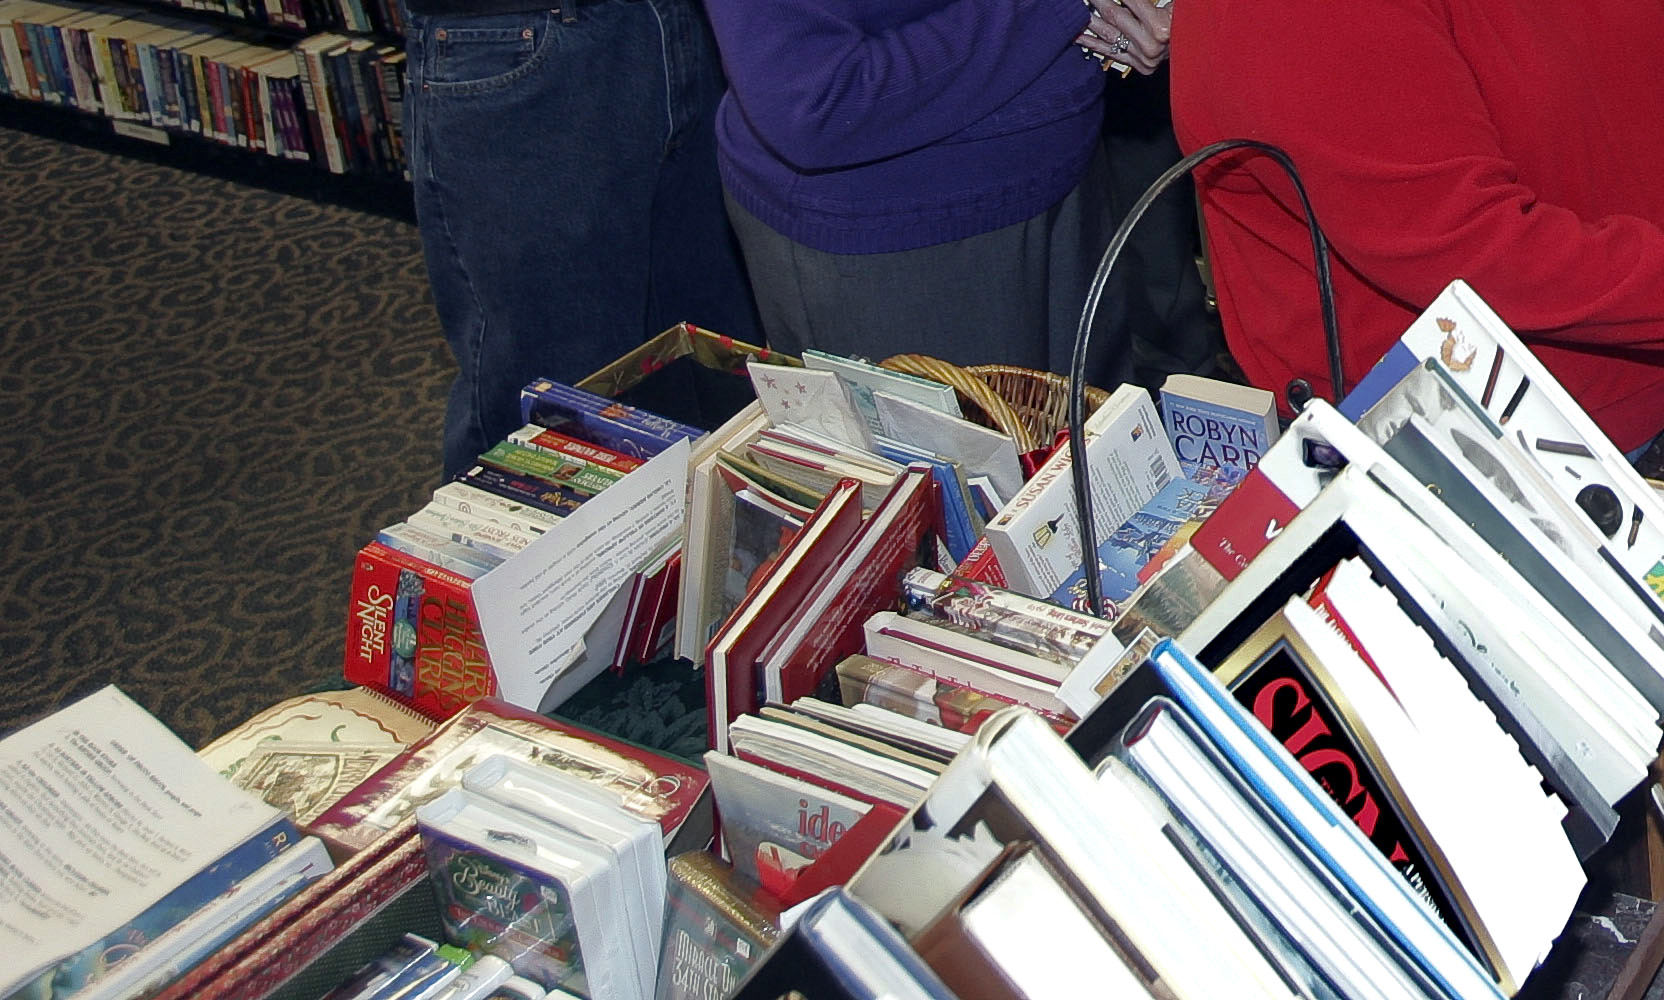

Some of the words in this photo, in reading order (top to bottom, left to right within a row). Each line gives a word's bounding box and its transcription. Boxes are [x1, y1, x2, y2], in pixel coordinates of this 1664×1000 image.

[1172, 410, 1259, 449] ROBYN
[1175, 435, 1261, 470] CARR
[1016, 473, 1057, 509] SUSAN
[356, 600, 373, 664] NIGHT
[367, 584, 394, 656] SILENT
[418, 596, 443, 698] CLARK
[439, 599, 469, 711] HIGGINS
[452, 865, 521, 912] Beauty
[673, 956, 700, 996] 34TH
[676, 930, 719, 984] MIRACLE
